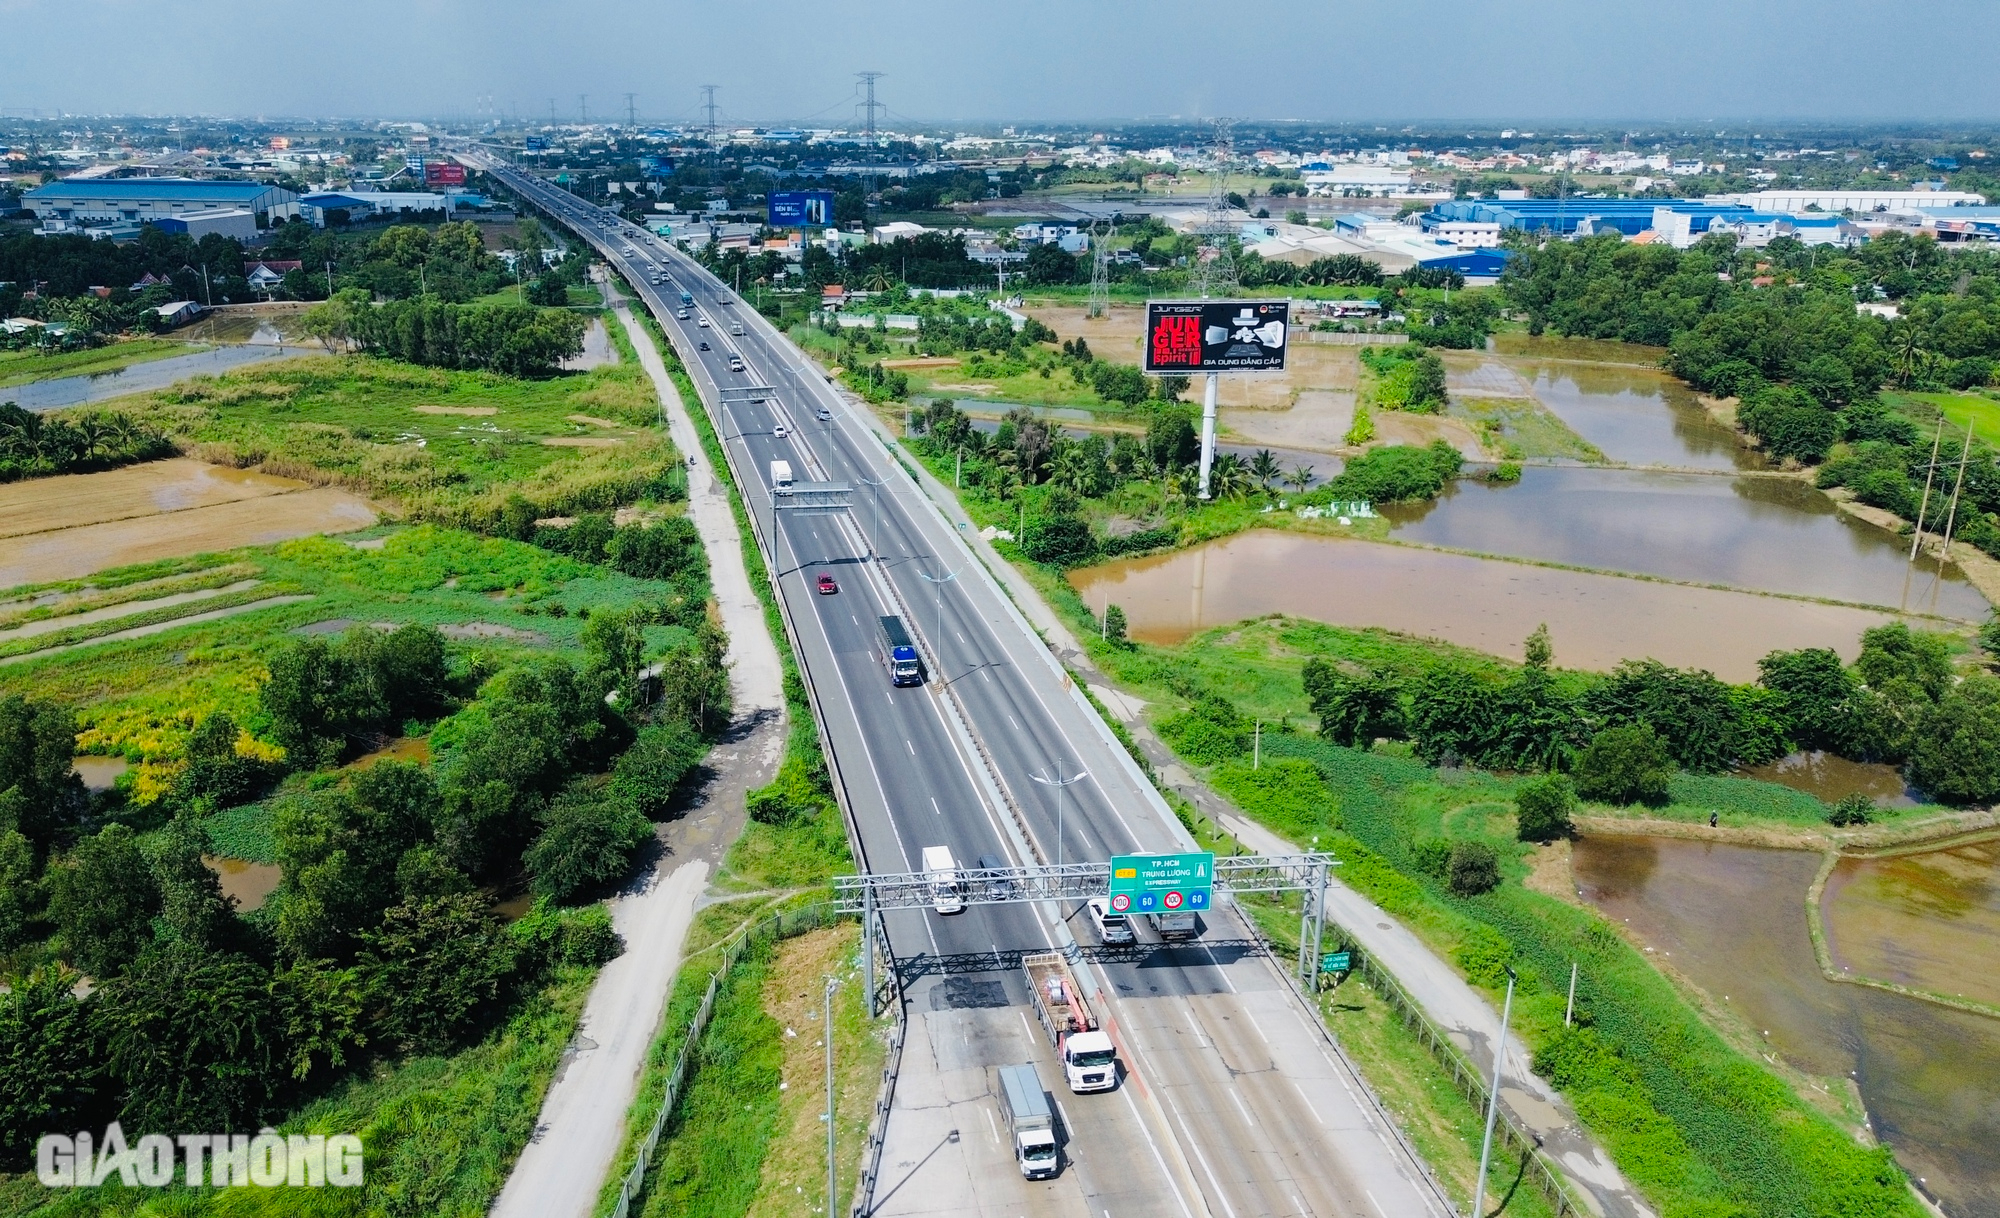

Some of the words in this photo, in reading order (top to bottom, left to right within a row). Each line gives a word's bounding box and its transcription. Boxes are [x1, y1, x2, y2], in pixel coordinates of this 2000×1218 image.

[1153, 305, 1203, 313] JUNGER
[1154, 316, 1200, 333] JUN
[1153, 331, 1201, 348] GER
[1151, 859, 1180, 868] TP.HCM
[1141, 870, 1166, 878] TRUNG
[1142, 897, 1152, 906] 60
[1192, 895, 1202, 904] 60
